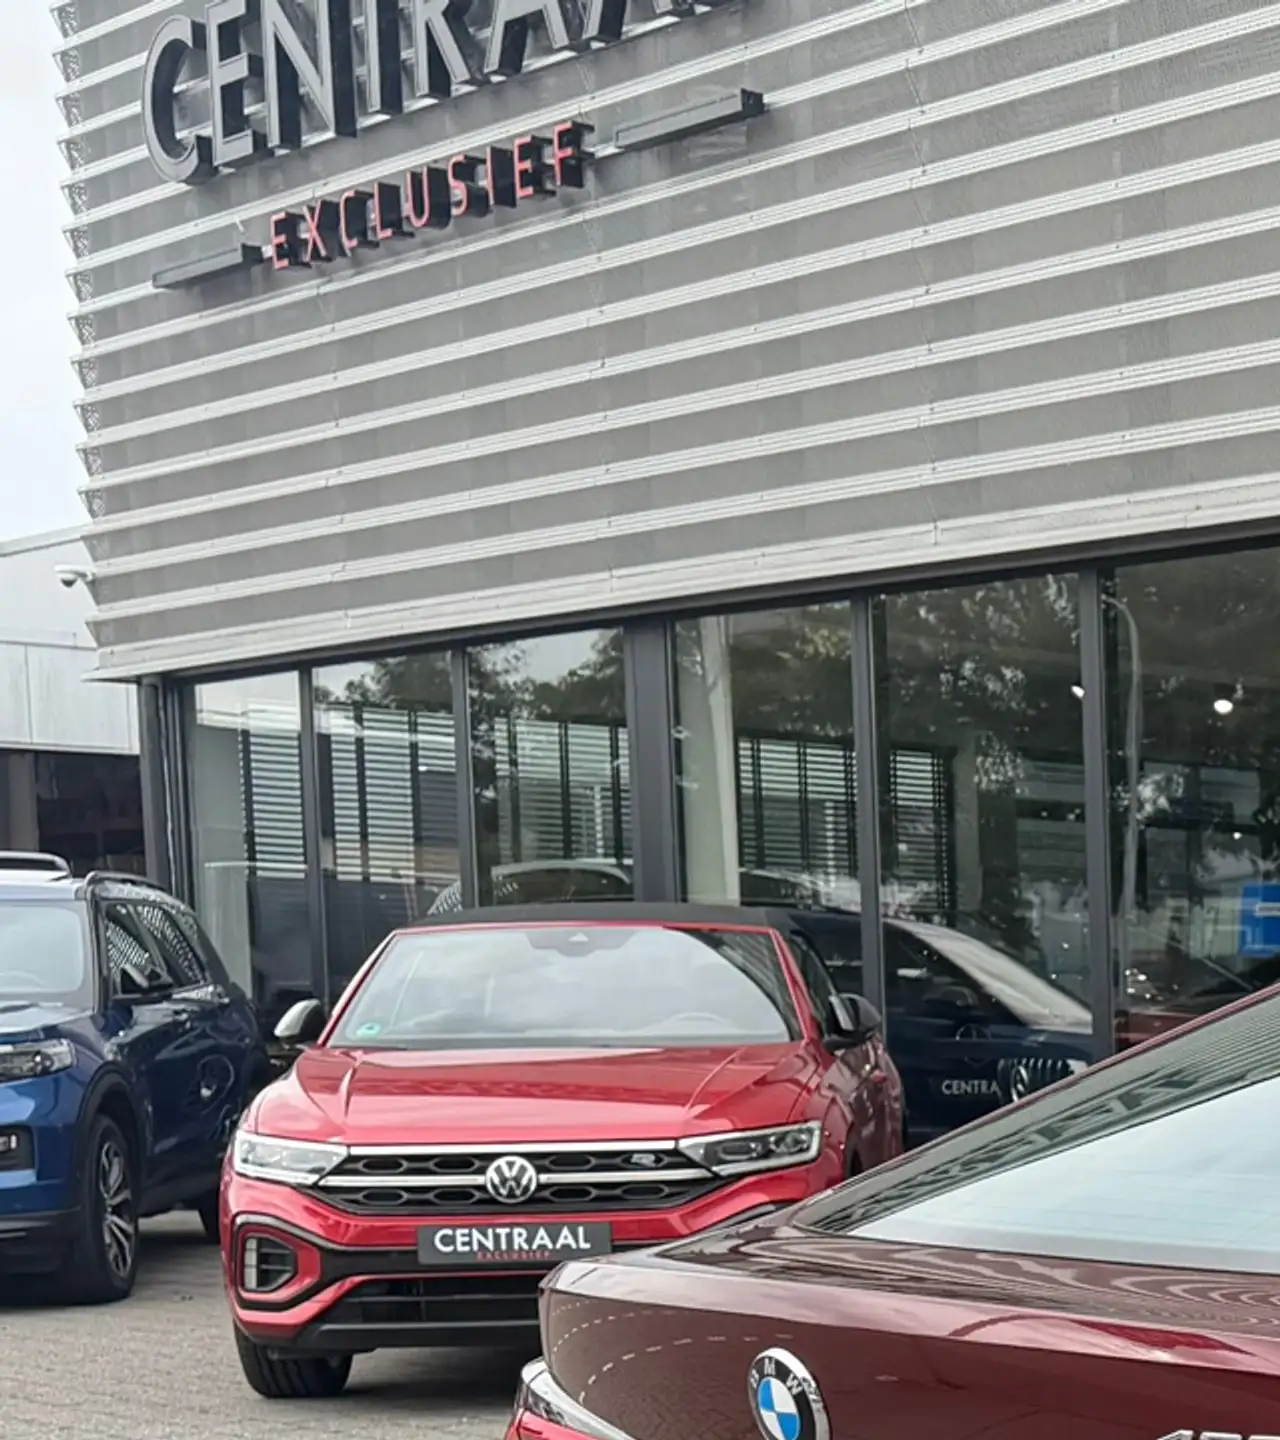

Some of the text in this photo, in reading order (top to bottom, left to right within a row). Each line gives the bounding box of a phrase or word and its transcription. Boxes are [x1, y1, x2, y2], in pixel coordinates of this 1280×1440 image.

[269, 120, 582, 270] EXCLUSIEF
[434, 1226, 591, 1252] CENTRAAL
[750, 1357, 803, 1395] BMW
